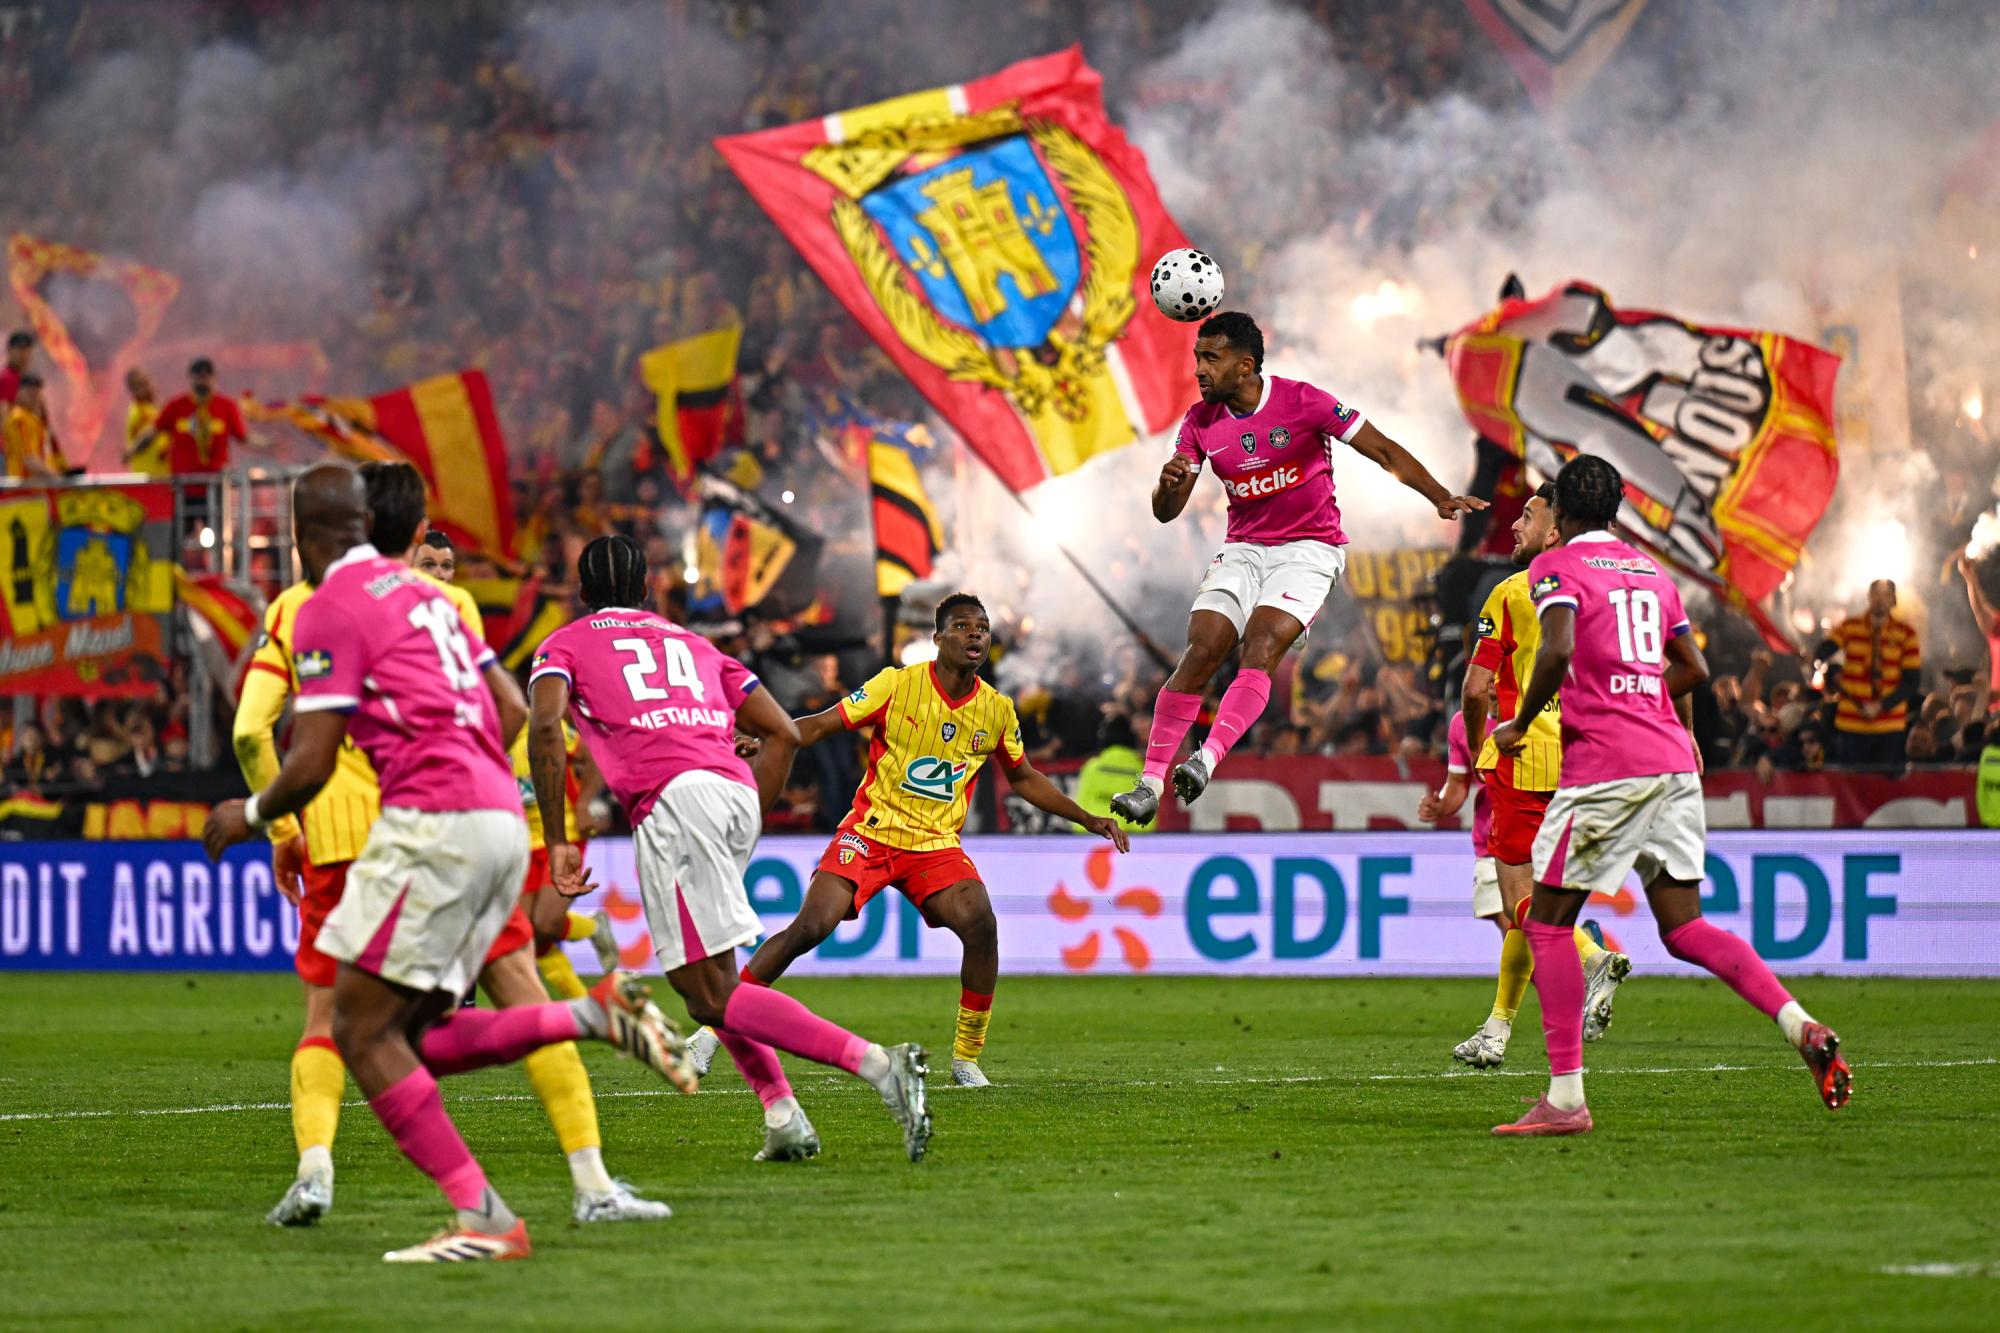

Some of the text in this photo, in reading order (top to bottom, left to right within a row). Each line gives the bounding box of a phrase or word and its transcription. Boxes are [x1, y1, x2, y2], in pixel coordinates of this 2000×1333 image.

[1223, 467, 1299, 497] Betclic
[1608, 588, 1662, 664] 18
[612, 637, 704, 703] 24
[2, 862, 87, 956] DIT
